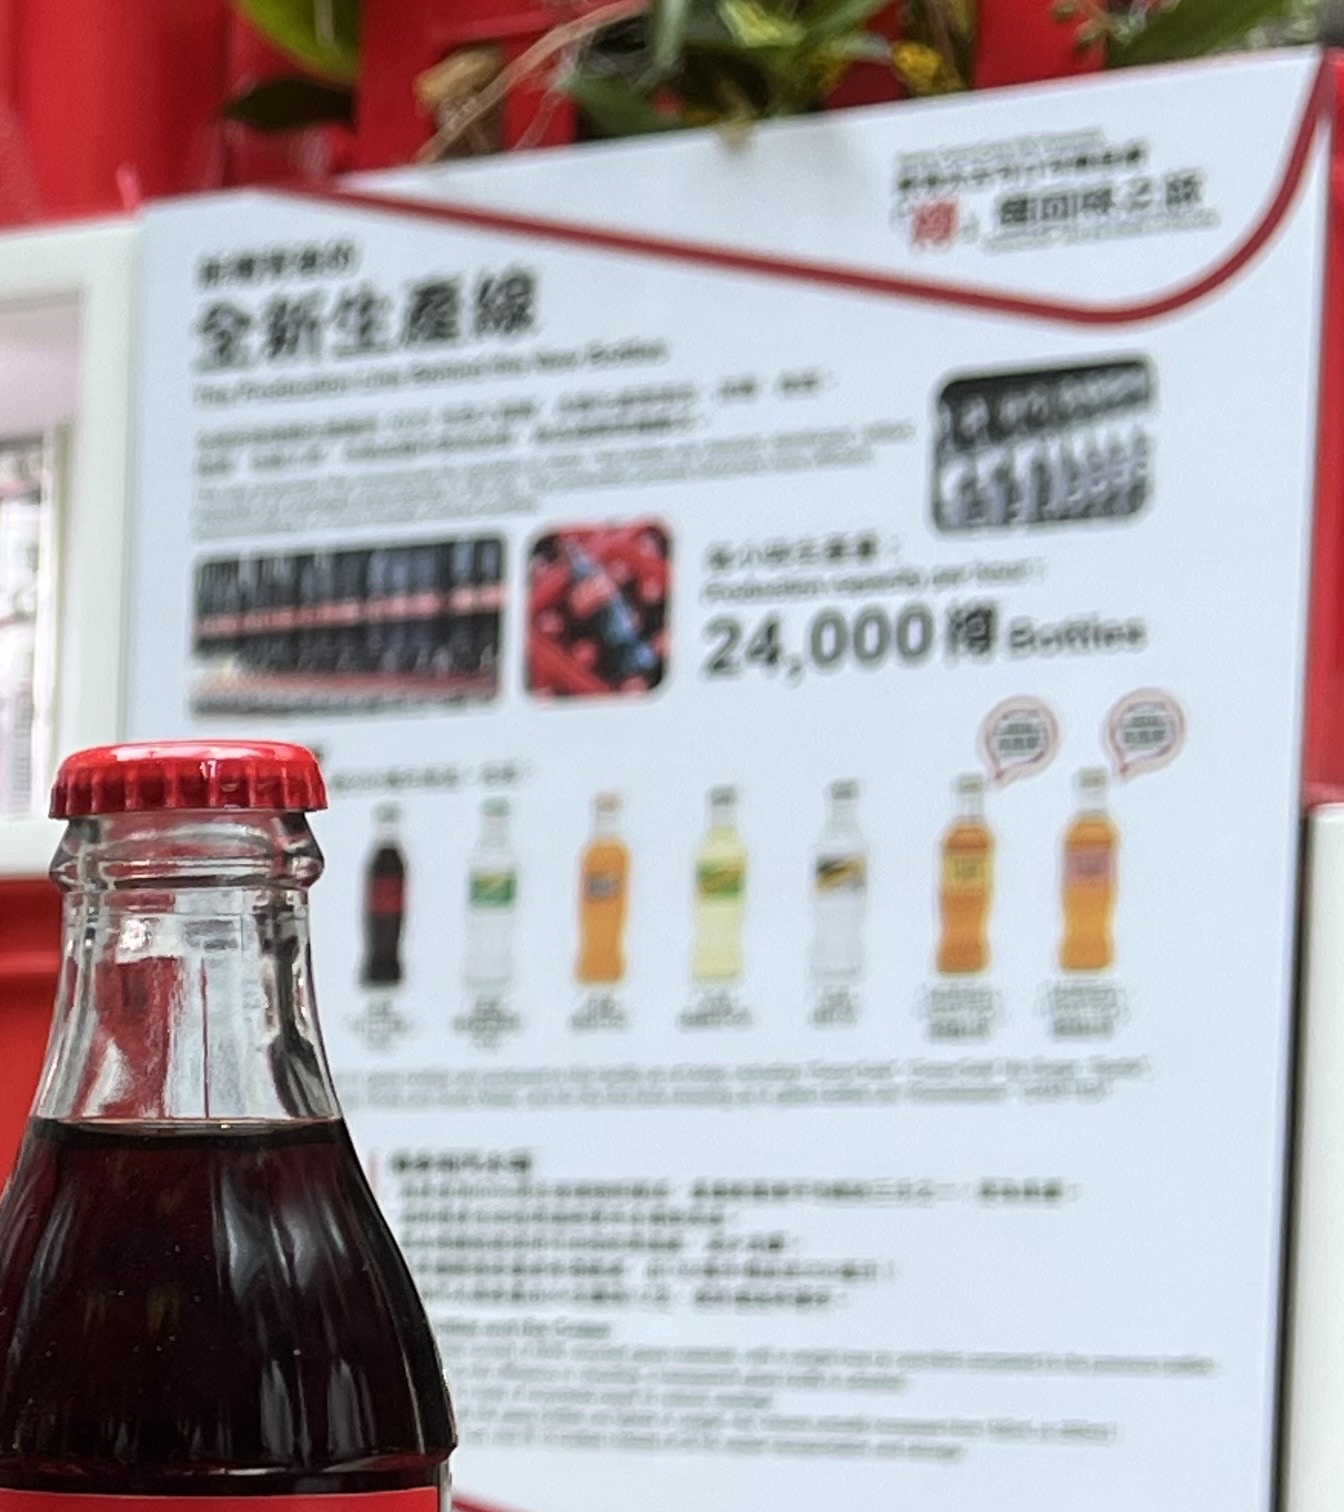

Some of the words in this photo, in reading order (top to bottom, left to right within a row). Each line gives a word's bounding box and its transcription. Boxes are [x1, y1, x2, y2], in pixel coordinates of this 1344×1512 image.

[194, 263, 540, 371] 全新生產線
[1007, 616, 1147, 651] Bottles
